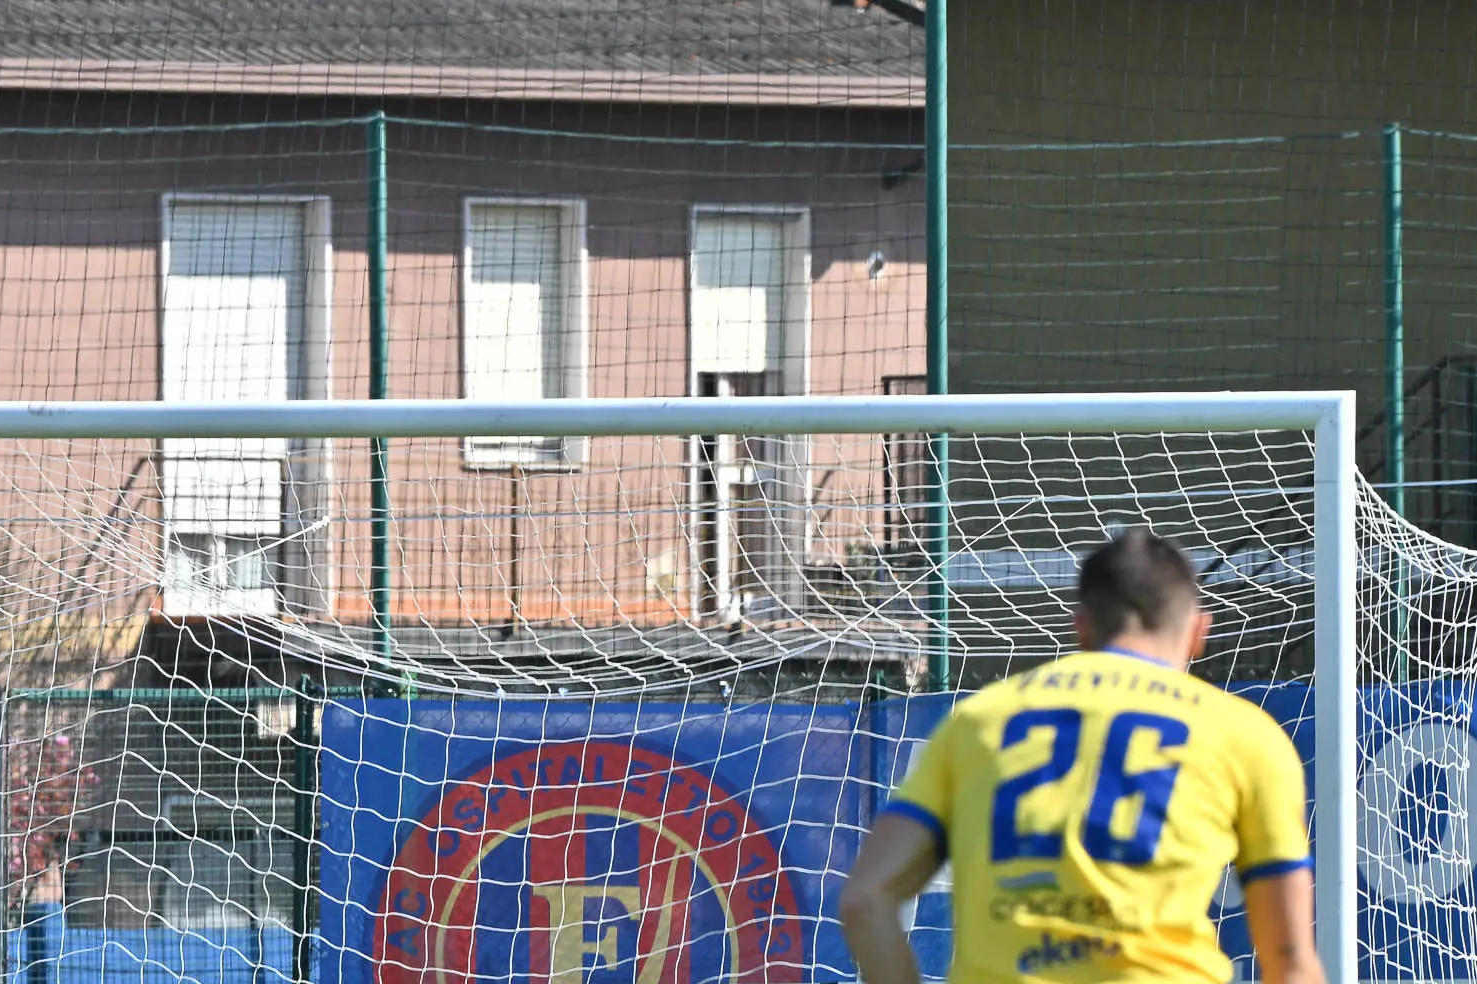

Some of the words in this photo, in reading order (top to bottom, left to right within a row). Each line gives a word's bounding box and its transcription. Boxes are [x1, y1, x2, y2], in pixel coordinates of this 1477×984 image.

[387, 889, 424, 956] AC
[426, 753, 740, 859] OSPITALETTO
[990, 707, 1190, 865] 26
